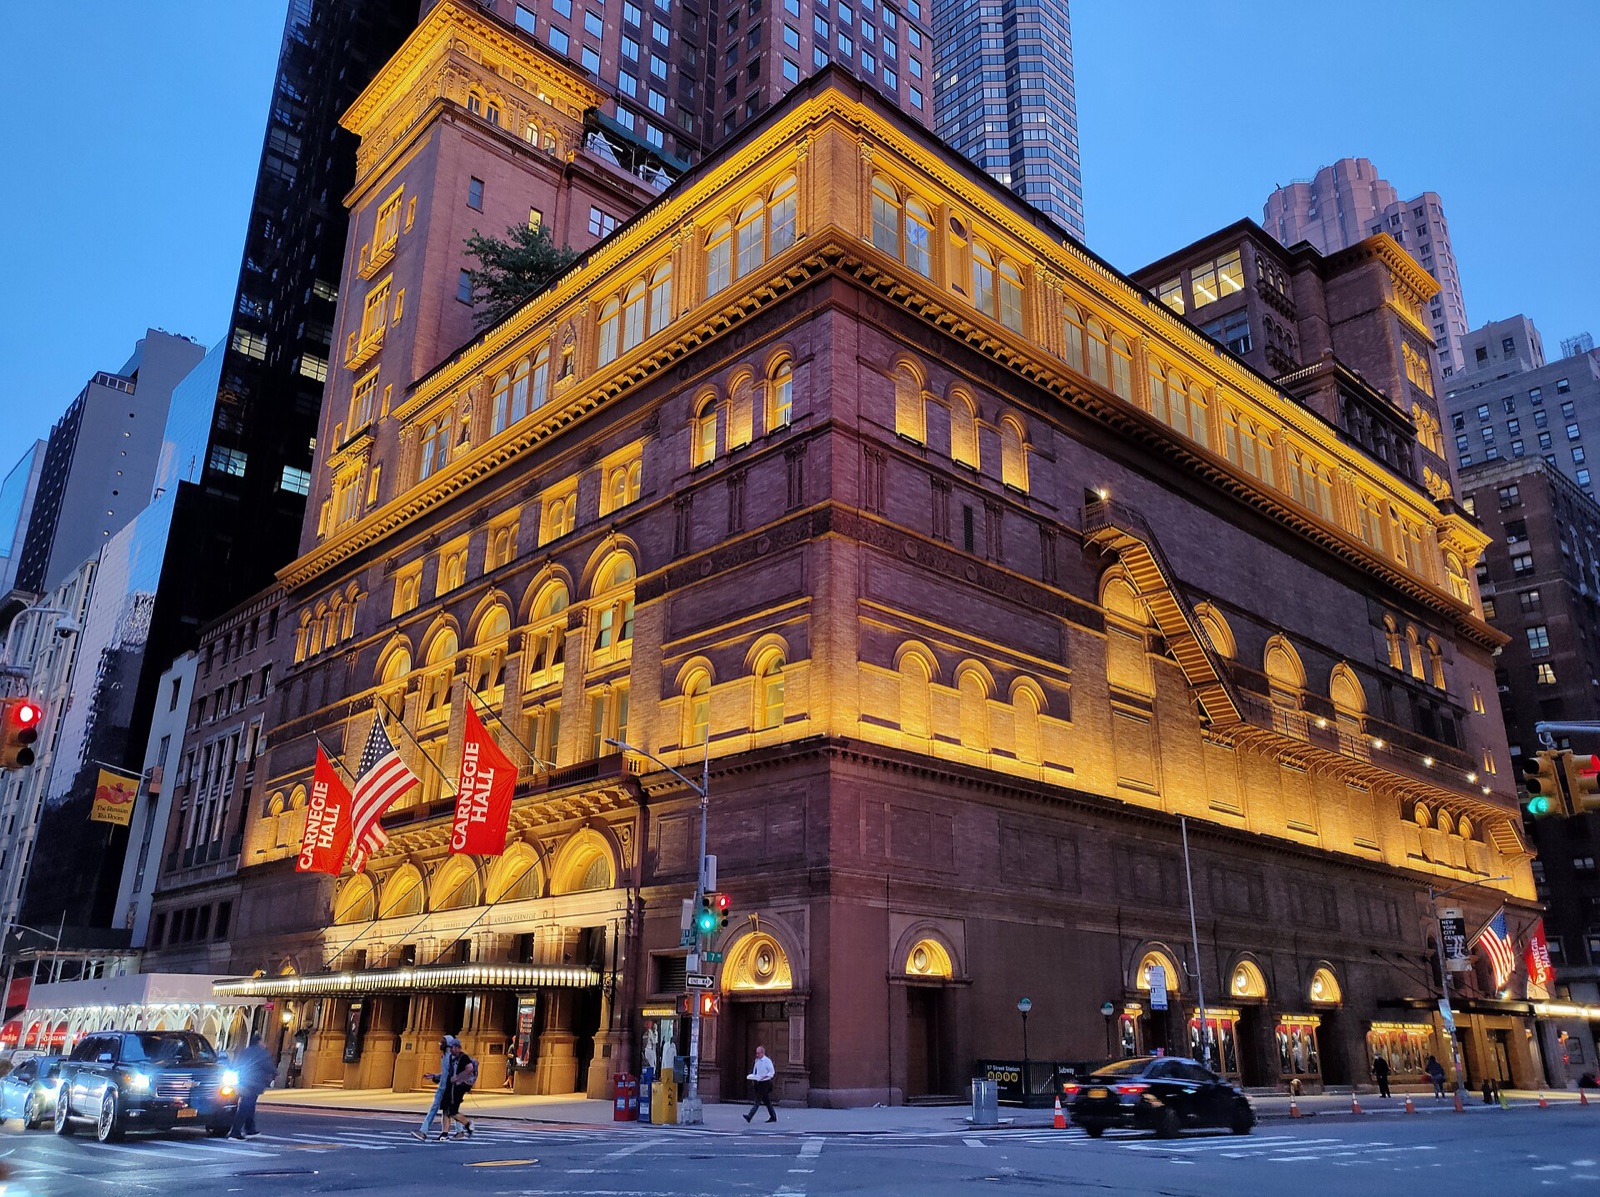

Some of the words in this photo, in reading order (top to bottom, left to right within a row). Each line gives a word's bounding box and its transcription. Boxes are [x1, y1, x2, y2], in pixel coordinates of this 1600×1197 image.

[452, 742, 479, 850] CARNEGIE
[470, 767, 494, 823] HALL
[300, 781, 328, 869] CARNEGIE
[317, 804, 340, 848] HALL
[1531, 937, 1546, 982] CARNEGIE
[1539, 945, 1551, 968] HALL
[1058, 1066, 1075, 1075] Subway
